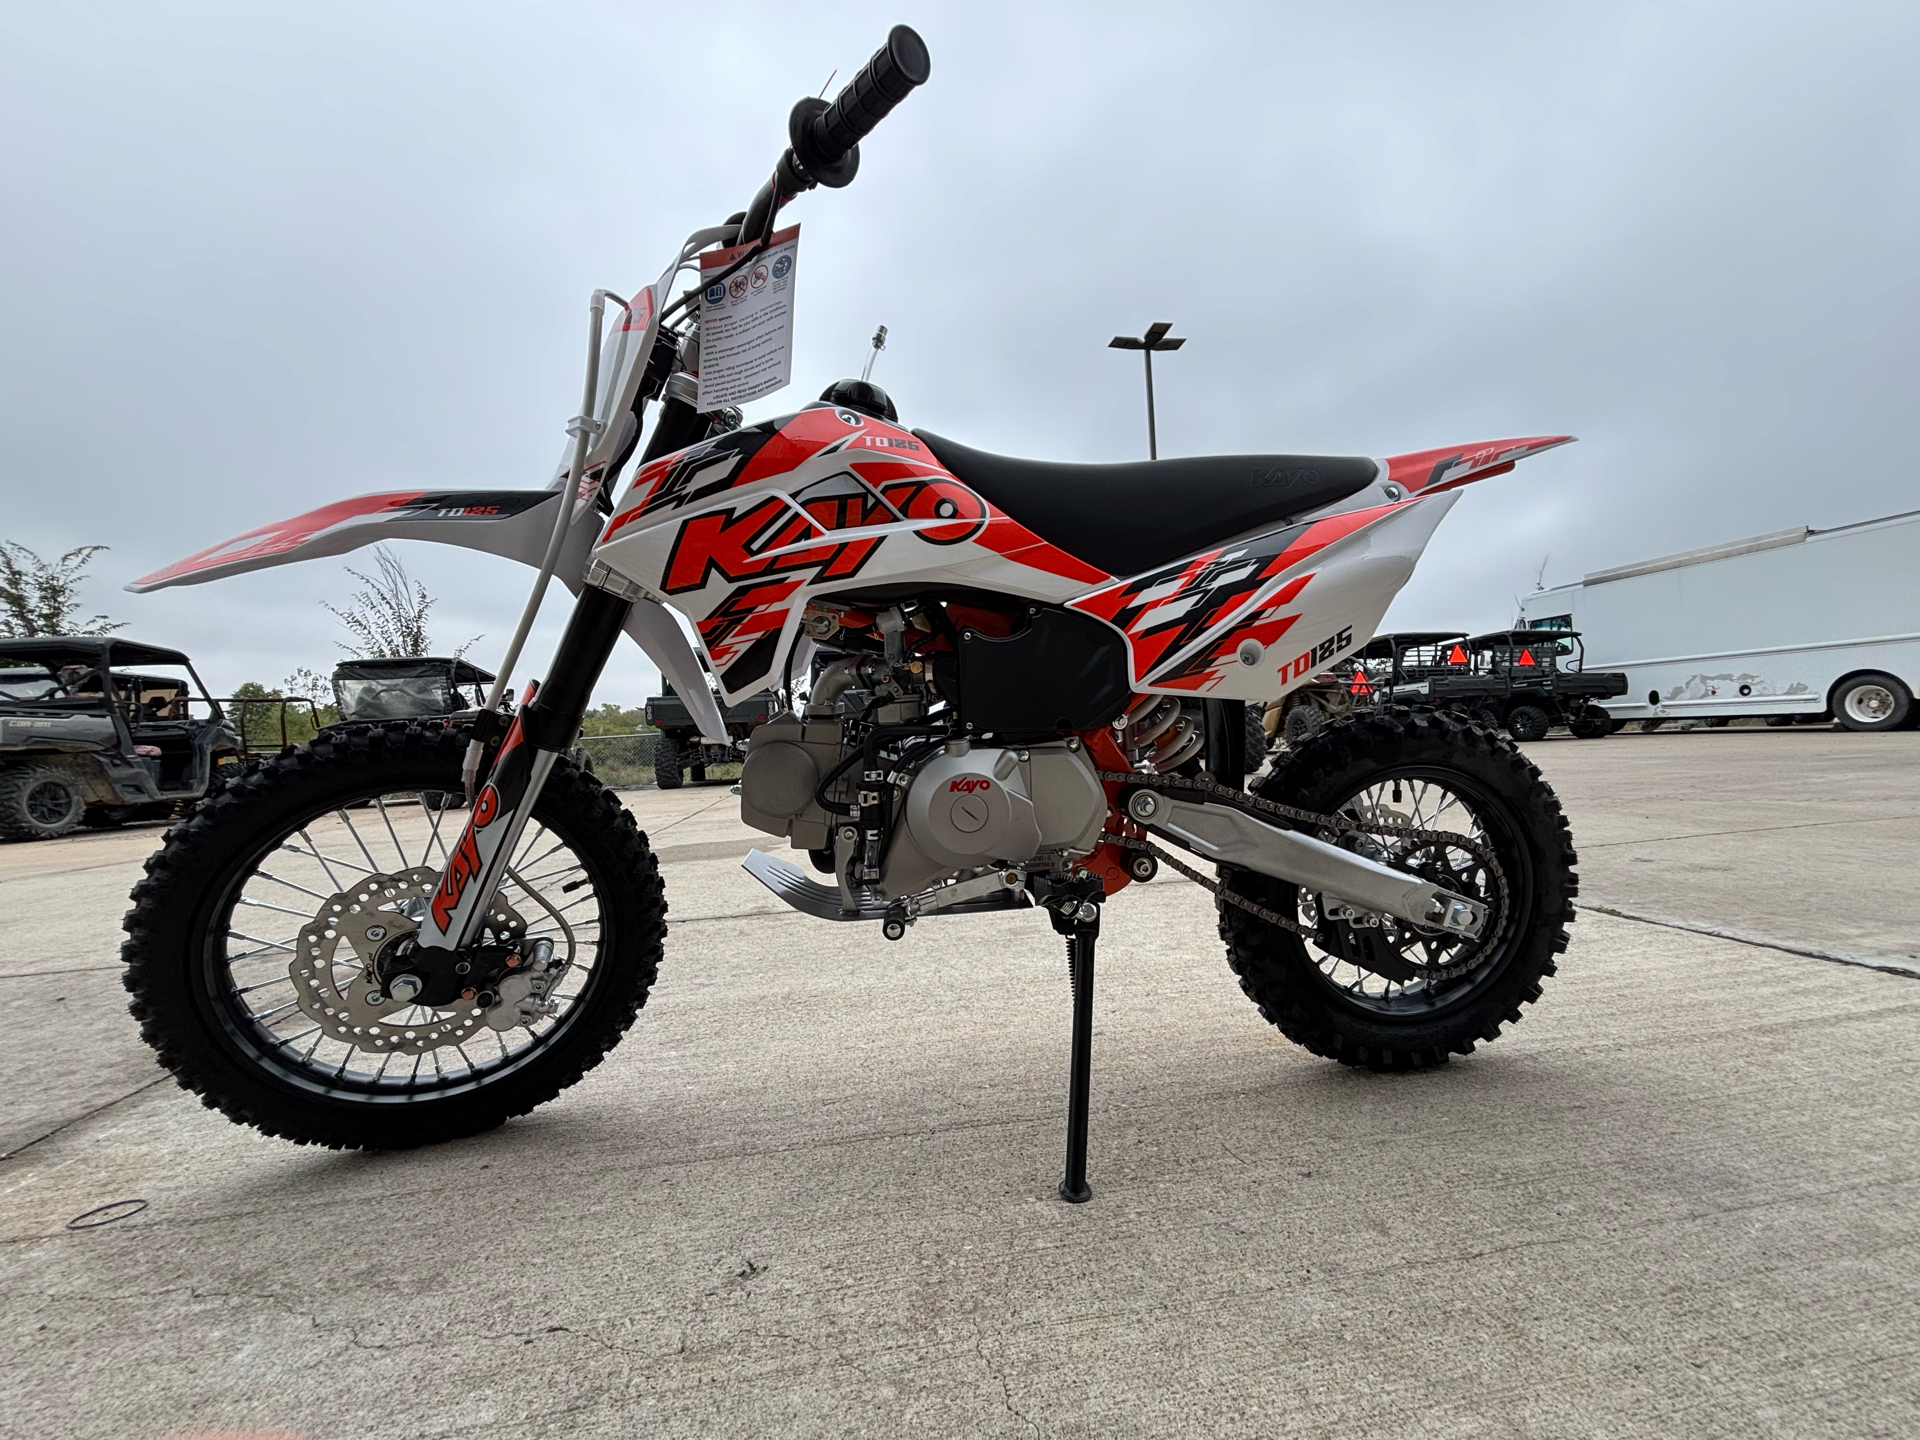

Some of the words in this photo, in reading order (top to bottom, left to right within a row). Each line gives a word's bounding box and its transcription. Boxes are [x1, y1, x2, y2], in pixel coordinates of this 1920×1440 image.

[724, 320, 738, 328] proper
[718, 346, 736, 355] passenger
[744, 370, 760, 379] pavement
[730, 391, 757, 402] INSTRUCTIONS
[861, 435, 920, 451] TD125
[1250, 462, 1322, 489] KAYO
[437, 505, 500, 517] TD125
[660, 472, 989, 596] KAYO
[1277, 624, 1353, 687] TD125
[949, 776, 991, 794] KAYO
[431, 784, 499, 937] KAYO
